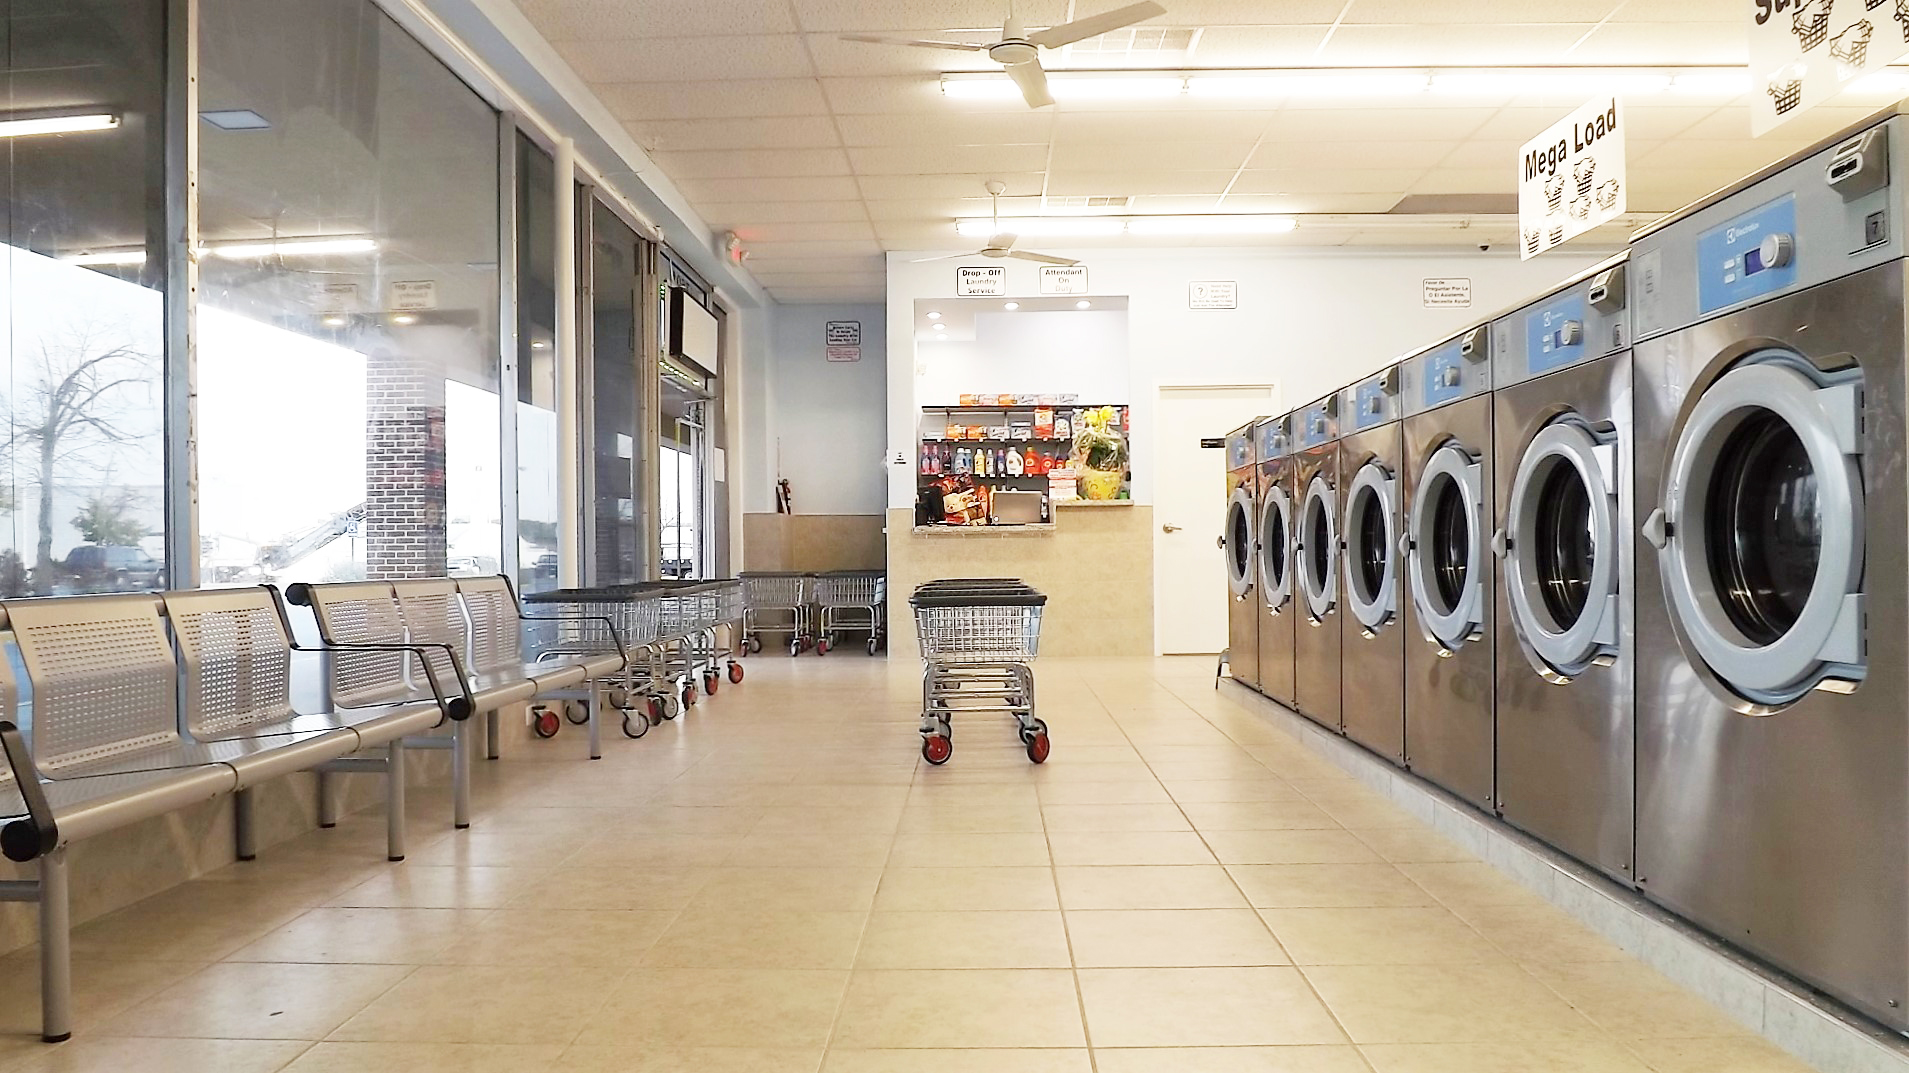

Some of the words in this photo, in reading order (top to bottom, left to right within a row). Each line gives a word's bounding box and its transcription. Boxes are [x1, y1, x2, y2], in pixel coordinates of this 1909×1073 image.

[1525, 138, 1567, 183] Mega
[1574, 96, 1617, 153] Load
[1871, 221, 1879, 234] 7
[962, 269, 981, 277] Drop
[966, 278, 997, 286] Laundry
[1055, 285, 1073, 294] Duty
